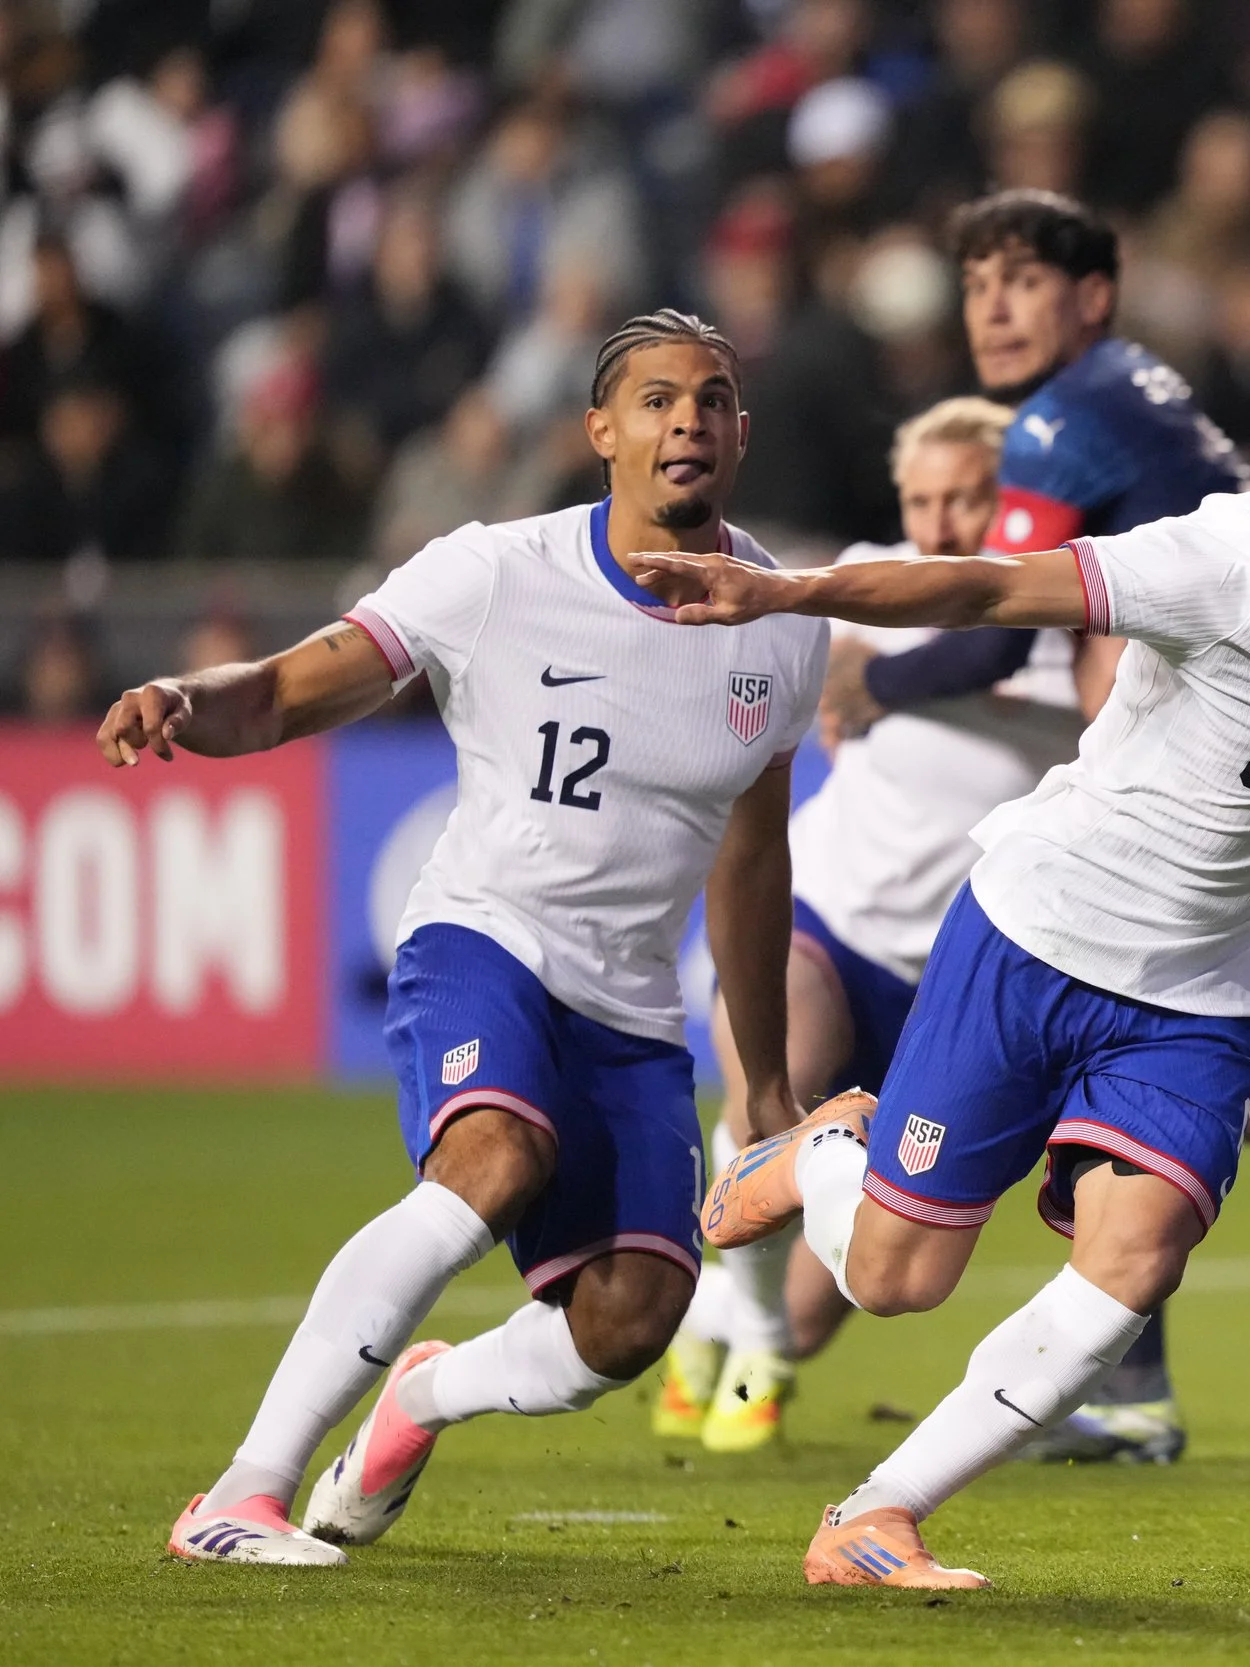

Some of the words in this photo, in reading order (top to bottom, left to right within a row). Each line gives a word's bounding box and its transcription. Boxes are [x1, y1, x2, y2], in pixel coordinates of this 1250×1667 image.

[731, 676, 769, 704] USA
[530, 720, 611, 811] 12
[445, 1043, 477, 1064] USA
[908, 1117, 943, 1144] USA
